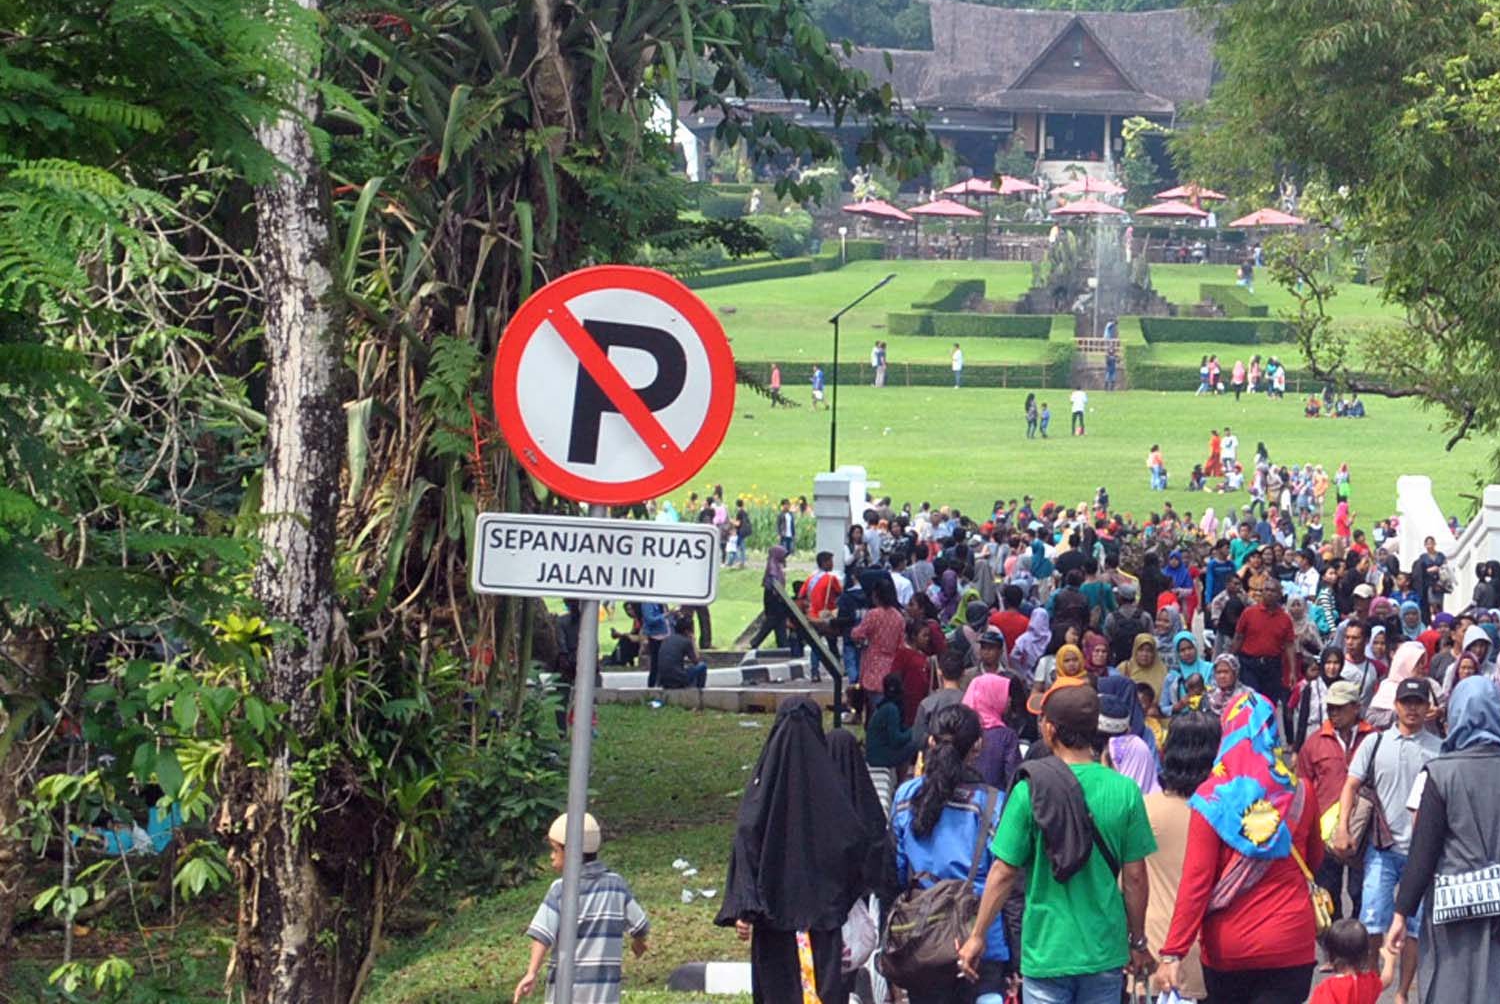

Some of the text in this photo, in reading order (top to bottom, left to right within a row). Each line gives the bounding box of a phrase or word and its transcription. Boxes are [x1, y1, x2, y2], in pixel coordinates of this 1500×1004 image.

[567, 319, 687, 465] P
[489, 528, 707, 560] SEPANJANG RUAS
[536, 562, 655, 589] JALAN INI
